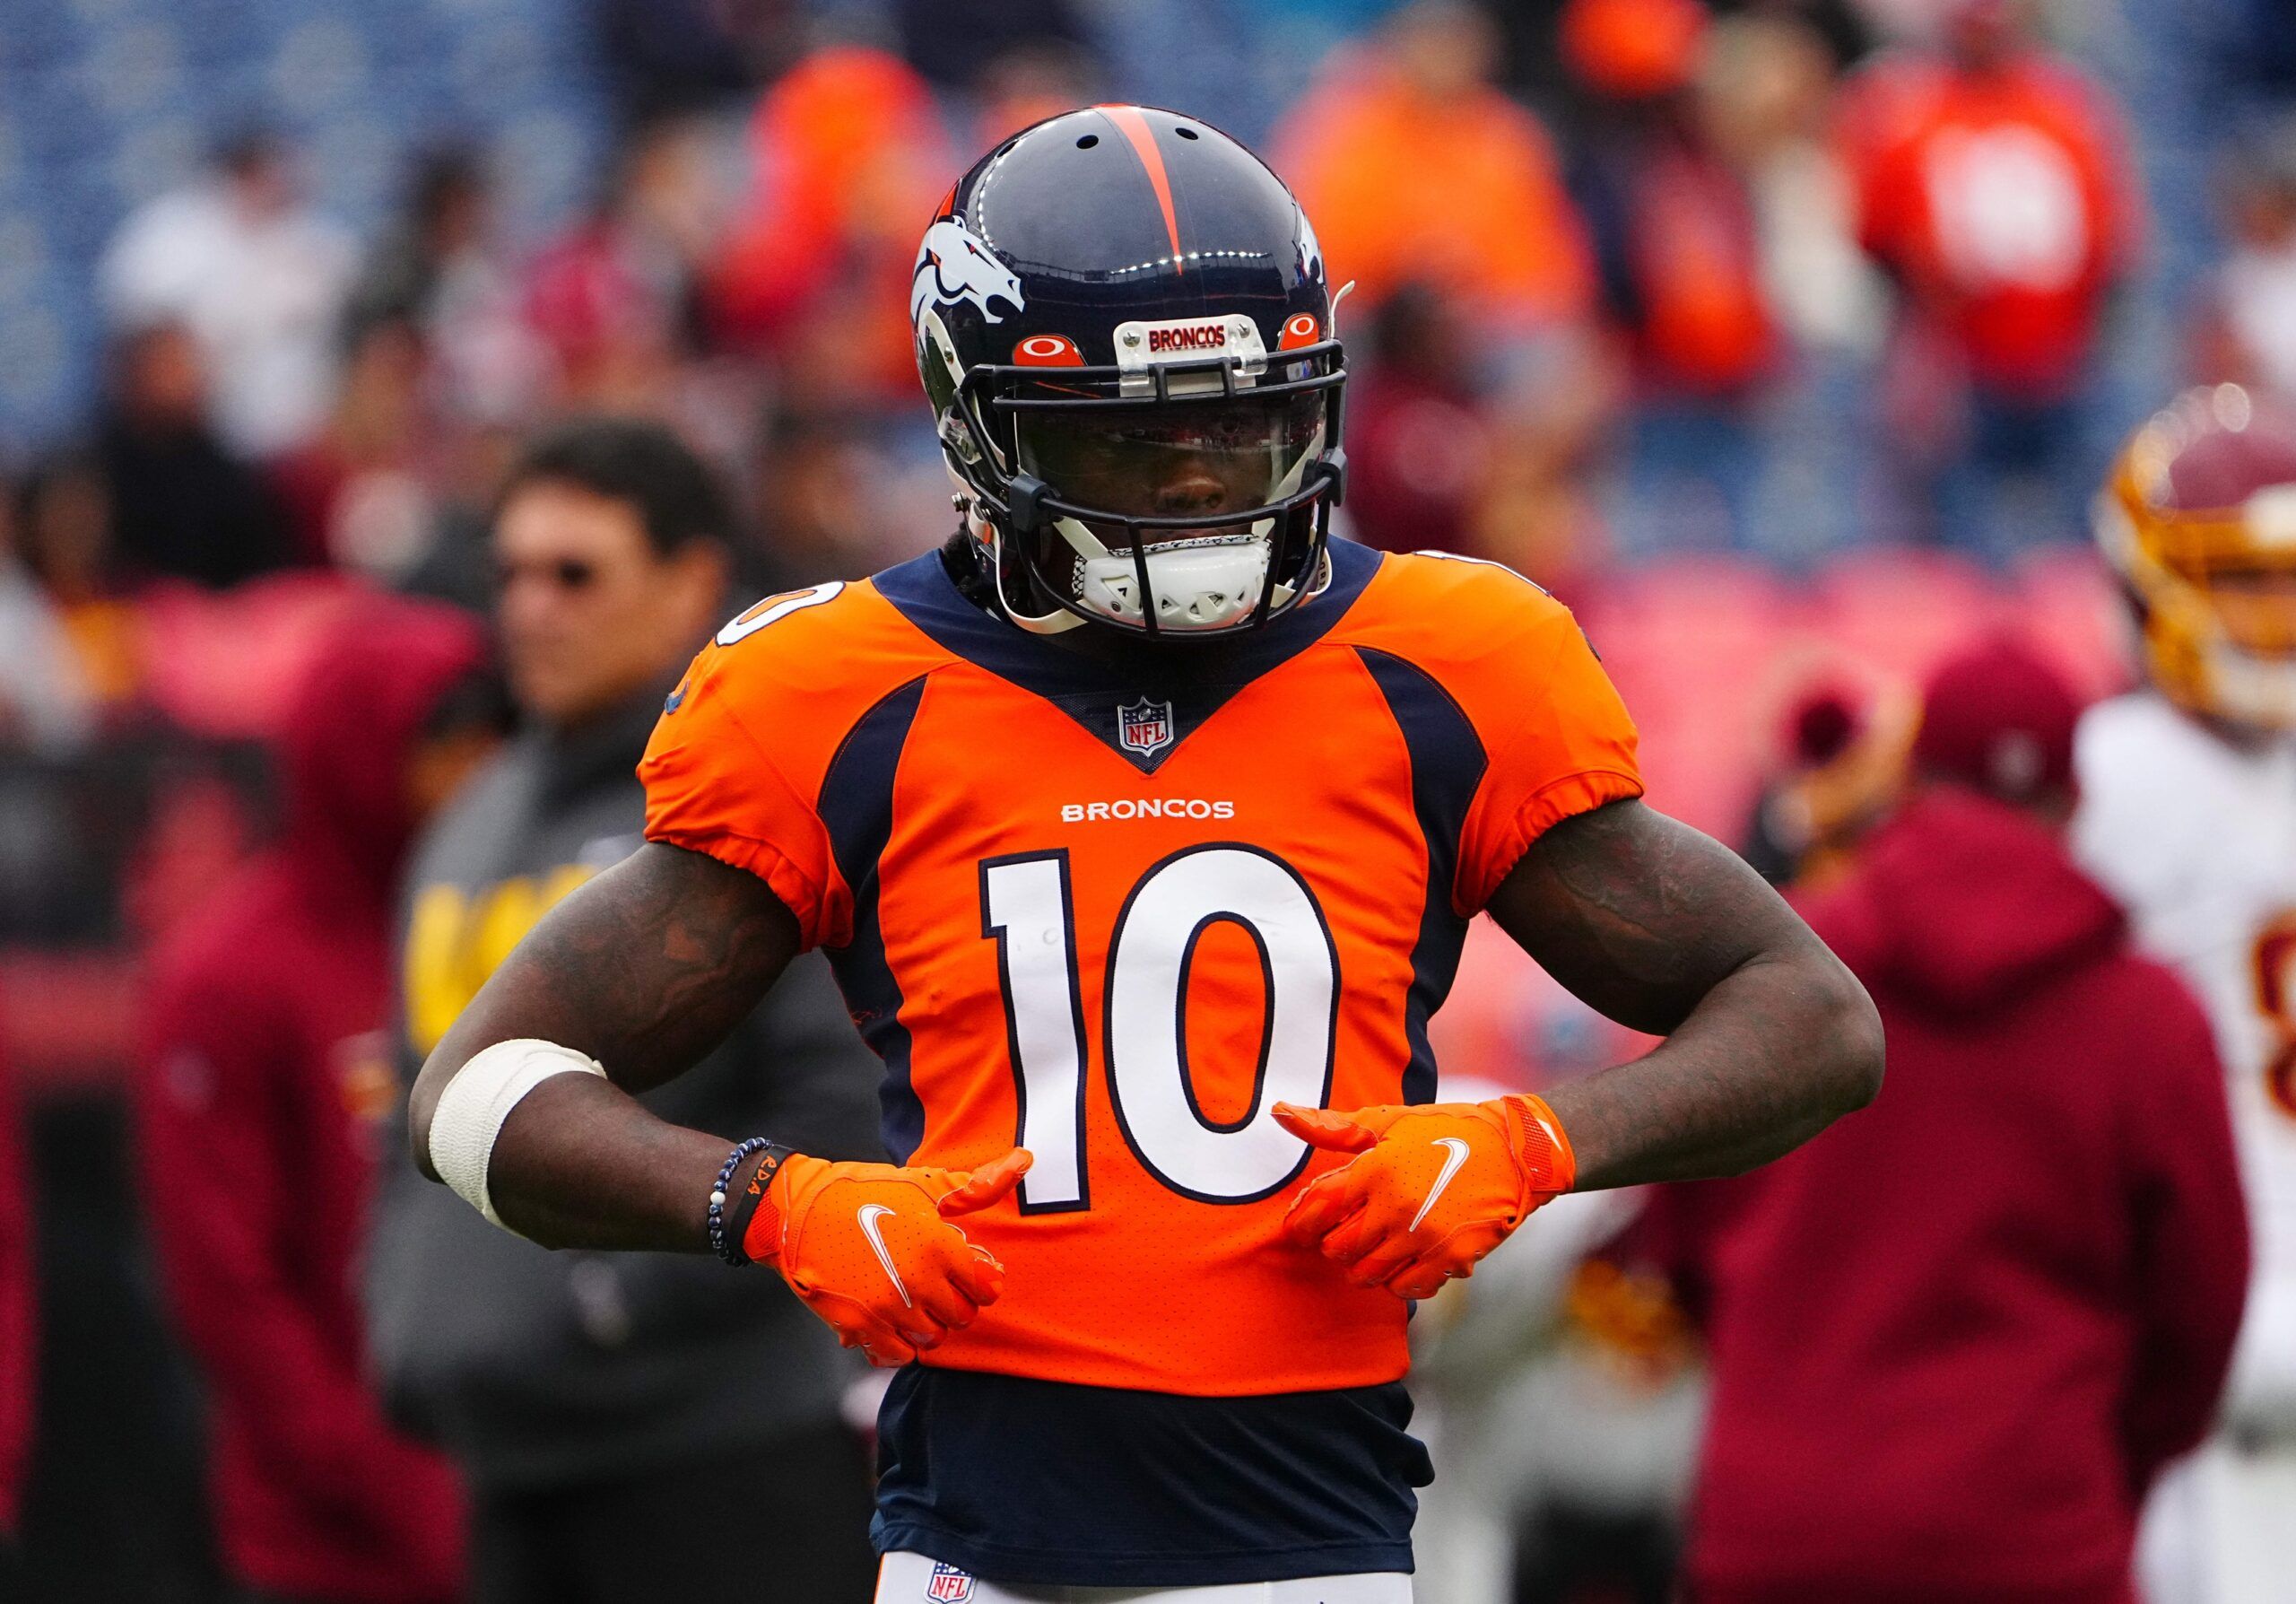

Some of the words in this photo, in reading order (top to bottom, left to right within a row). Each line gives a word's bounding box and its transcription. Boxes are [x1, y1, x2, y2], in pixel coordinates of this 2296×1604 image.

[1149, 325, 1225, 352] BRONCOS
[1126, 722, 1165, 745] NFL
[1060, 798, 1235, 823] BRONCOS
[978, 841, 1341, 1216] 10
[931, 1576, 965, 1600] NFL
